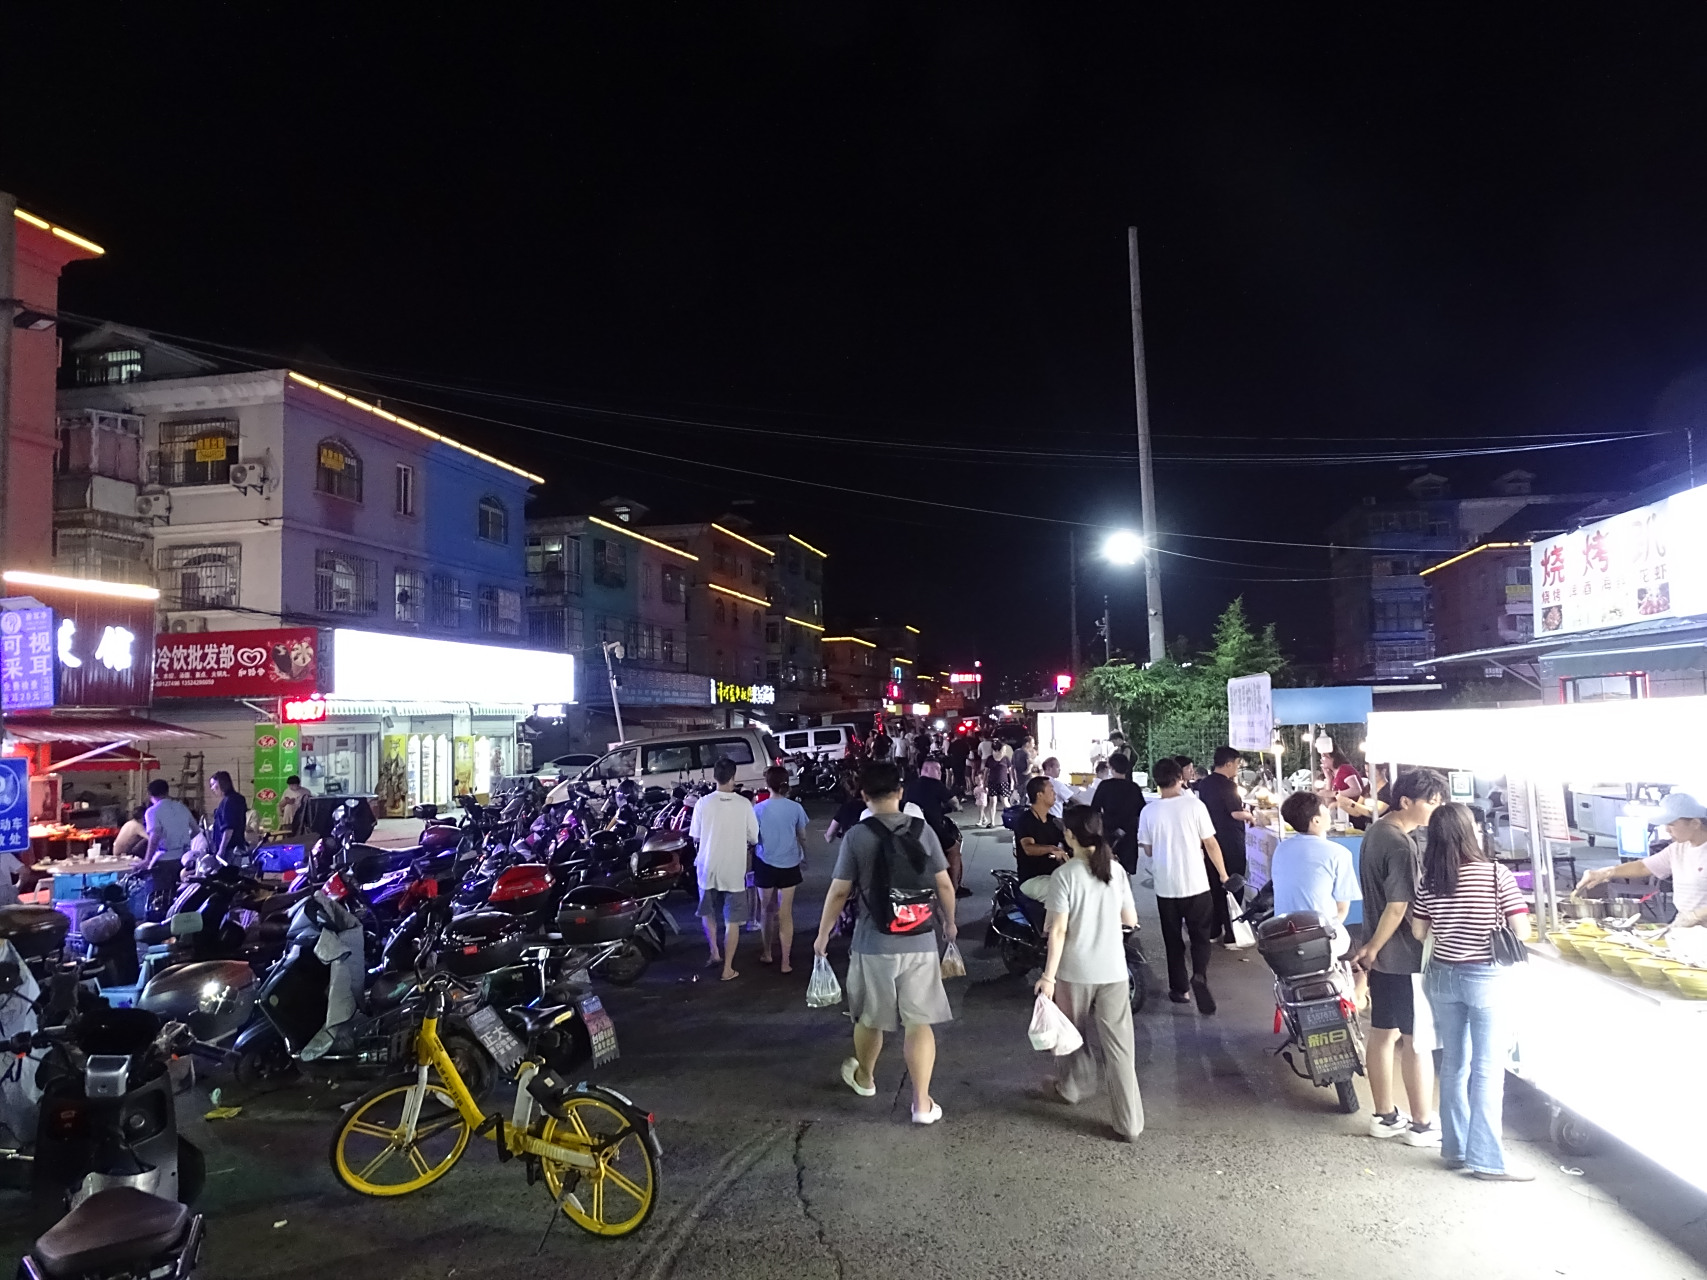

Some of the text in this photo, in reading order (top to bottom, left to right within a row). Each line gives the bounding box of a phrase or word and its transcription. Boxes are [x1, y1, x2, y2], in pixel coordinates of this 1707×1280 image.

[3, 631, 51, 656] 可视
[3, 654, 51, 680] 采耳
[156, 643, 235, 672] 冷饮批发部
[480, 1026, 510, 1047] 正大
[1308, 1029, 1348, 1048] 新日
